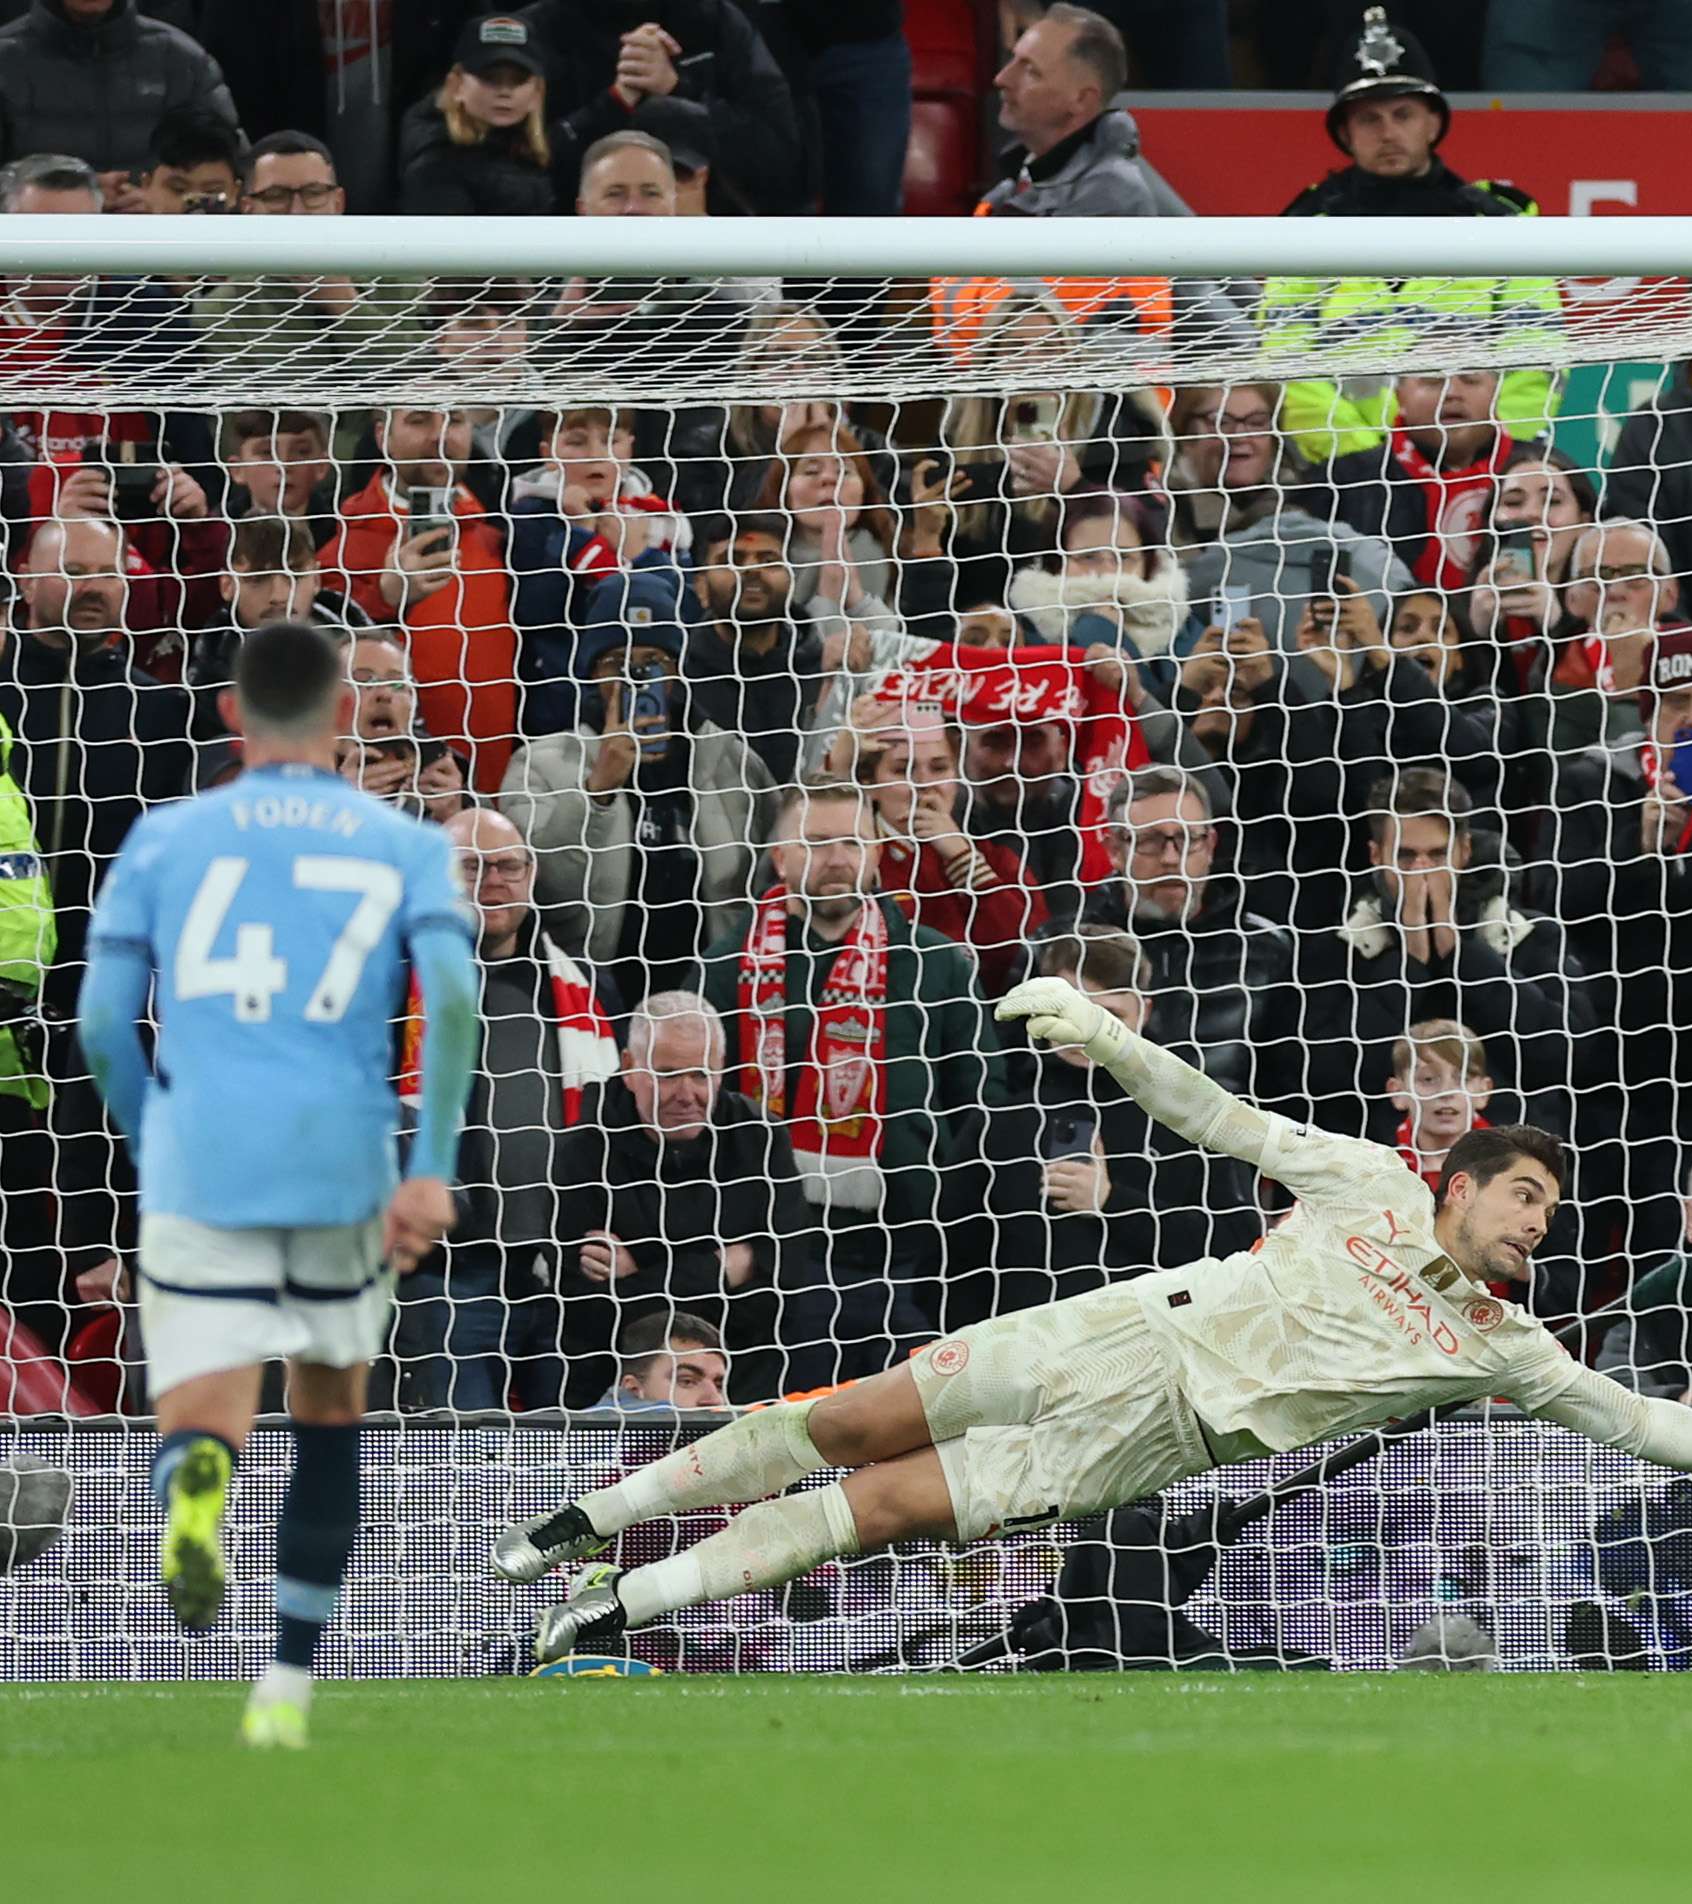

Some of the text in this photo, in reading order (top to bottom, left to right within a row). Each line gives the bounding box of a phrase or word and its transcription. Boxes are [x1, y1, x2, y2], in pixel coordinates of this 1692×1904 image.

[231, 796, 363, 839] FODEN
[174, 855, 404, 1024] 47
[1346, 1236, 1459, 1355] ETIHAD
[1358, 1273, 1423, 1346] AIRWAYS
